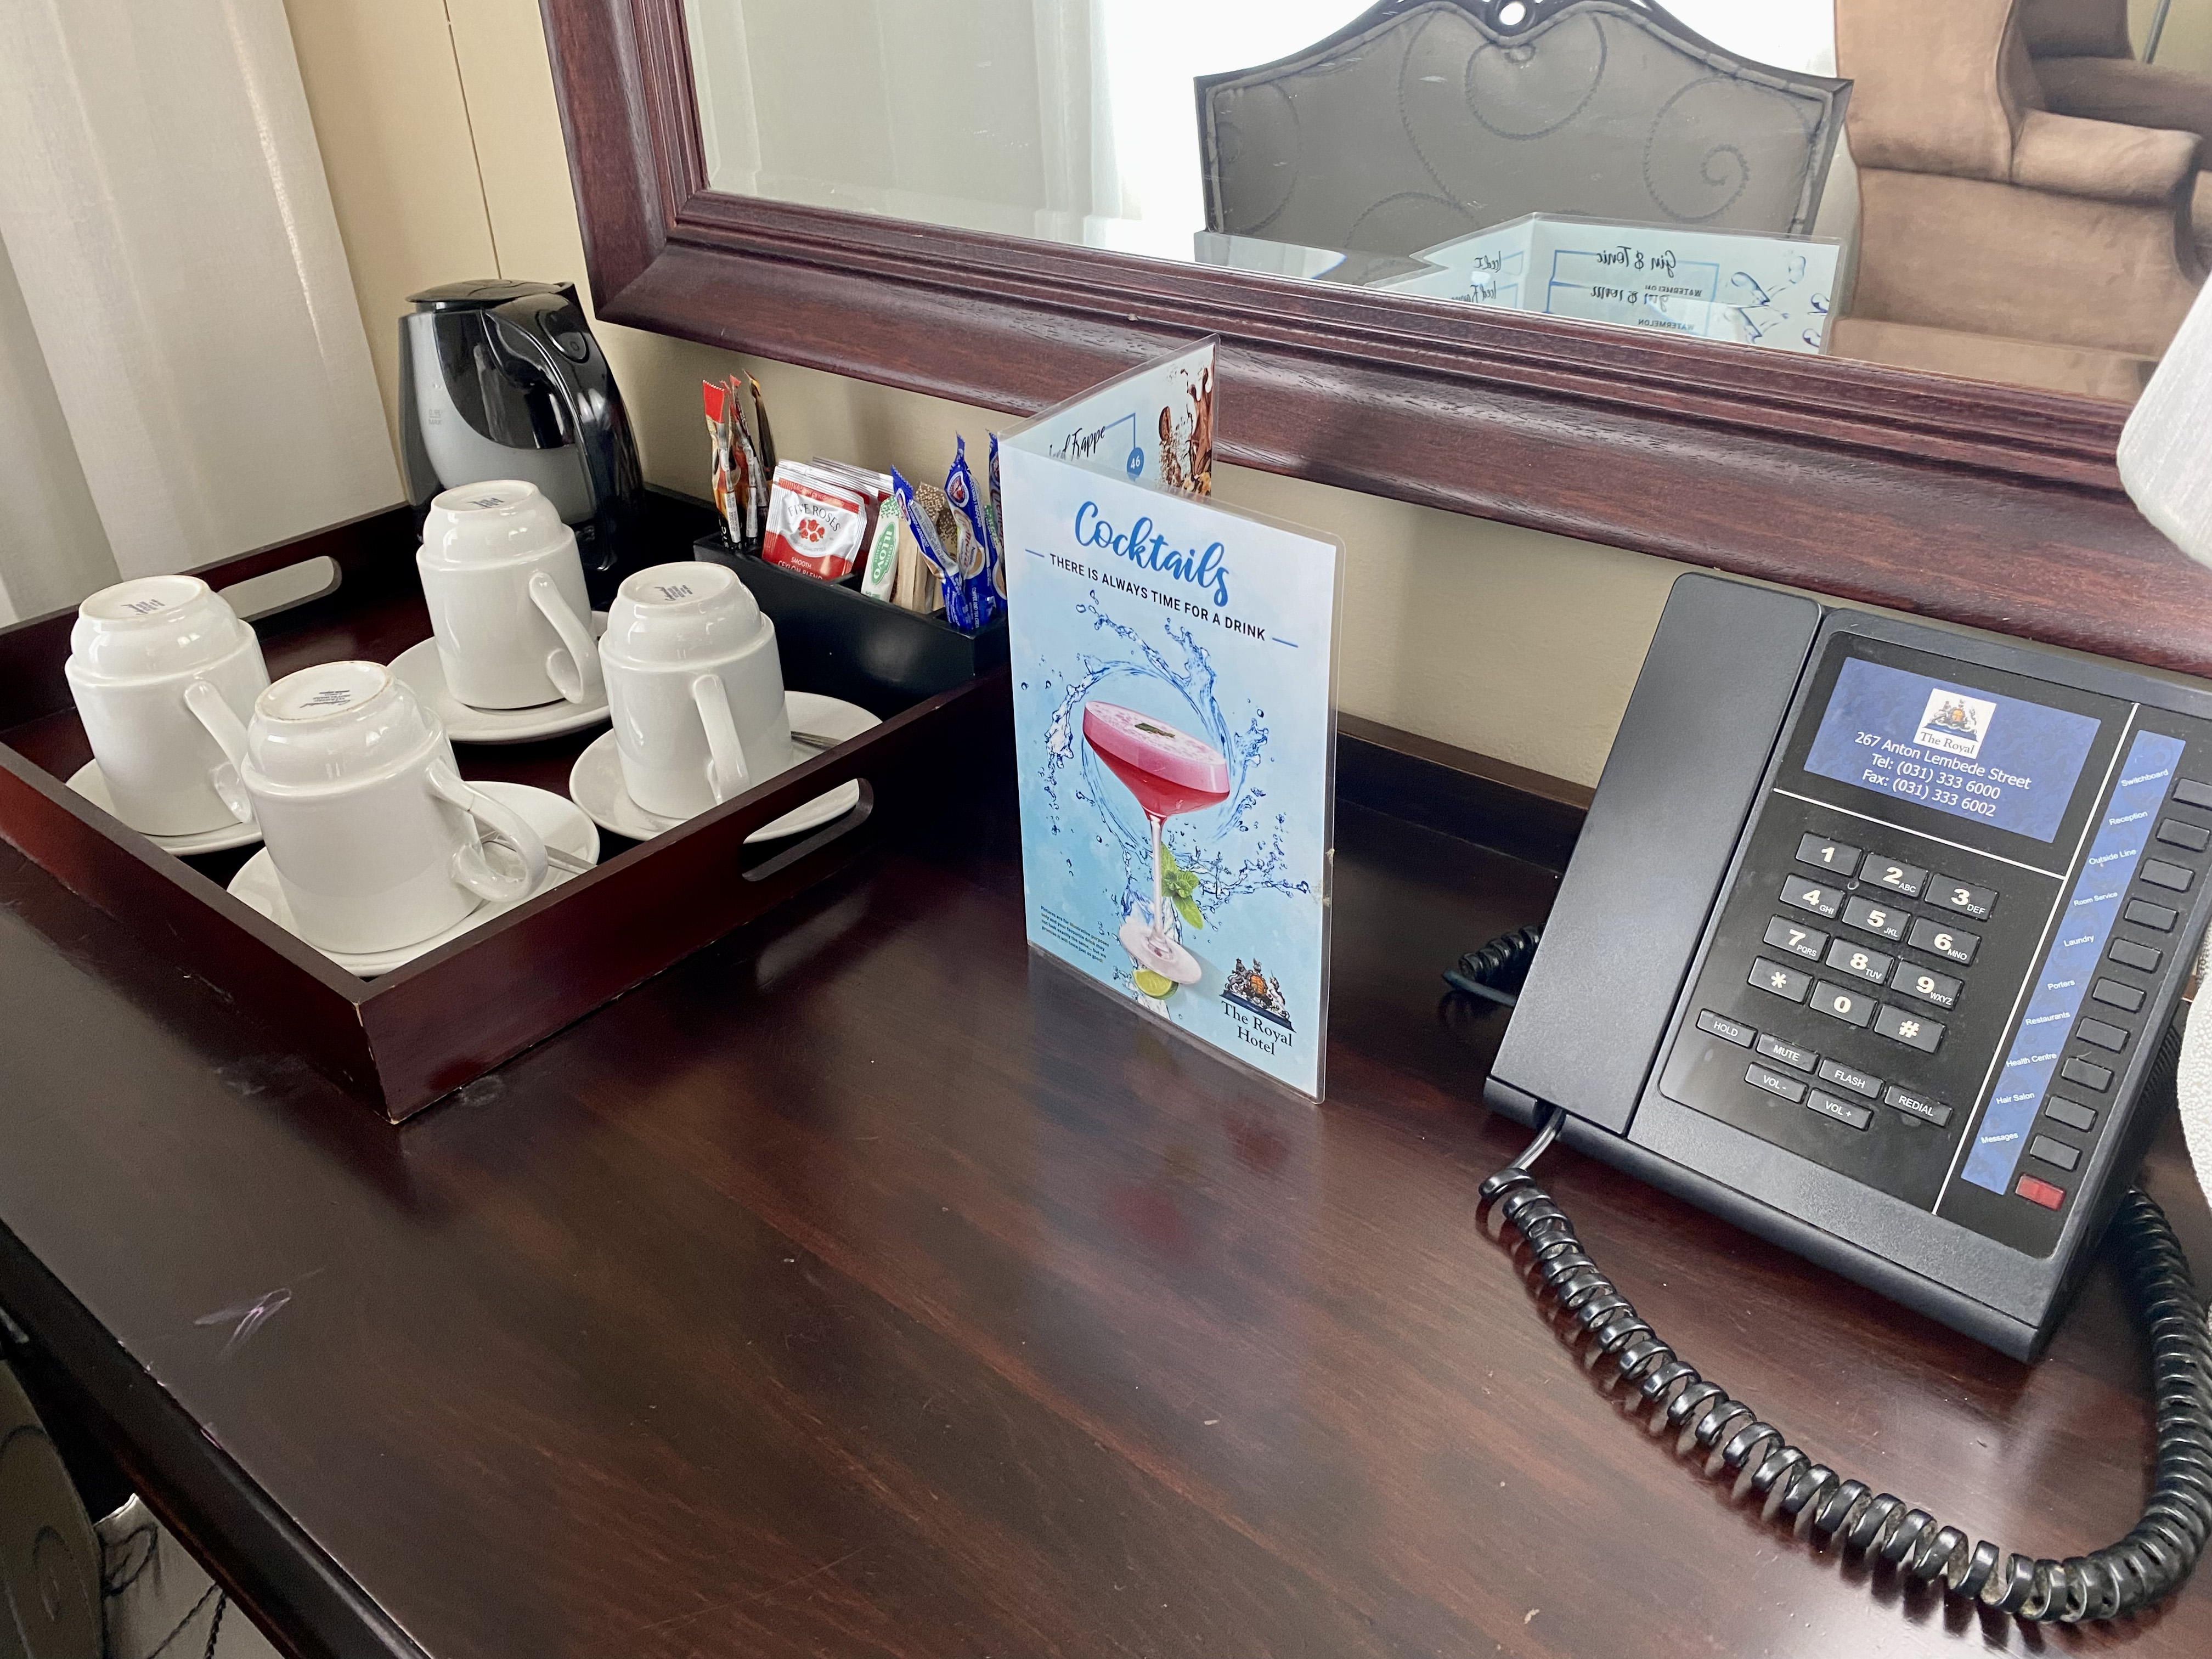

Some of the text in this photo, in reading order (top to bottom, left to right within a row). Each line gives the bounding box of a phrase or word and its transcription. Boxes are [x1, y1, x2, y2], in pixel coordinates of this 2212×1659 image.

[1071, 426, 1105, 461] Frappe
[1131, 455, 1140, 469] 46
[788, 503, 841, 532] FIVE ROSES
[791, 556, 812, 569] SMOOTH
[873, 531, 893, 579] ILLOVO
[1075, 501, 1229, 607] Cocktails
[1049, 554, 1266, 641] THERE IS ALWAYS TIME FOR A DRINK
[1920, 732, 1975, 754] The Royal
[1855, 731, 2032, 790] 267 Anton Lembede Street
[1872, 753, 2001, 799] Tel: (031) 333 6000
[2121, 769, 2169, 787] Switchboard
[1862, 769, 1996, 817] Fax: (031) 333 6002
[2109, 811, 2148, 826] Reception
[1821, 847, 1835, 863] 1
[2089, 849, 2136, 865] Outside Line
[1882, 866, 1903, 885] 2
[1898, 882, 1917, 894] ABC
[1951, 888, 1970, 905] 3
[1802, 889, 1820, 906] 4
[2074, 891, 2118, 906] Room Service
[1819, 903, 1835, 915] GHI
[1967, 904, 1985, 915] DEF
[1867, 910, 1887, 928] 5
[1788, 929, 1807, 946] 7
[1883, 927, 1899, 938] JKL
[2063, 935, 2094, 947] Laundry
[1797, 944, 1818, 957] PQRS
[1934, 933, 1953, 951] 6
[1850, 952, 1869, 970] 8
[1947, 949, 1968, 961] MNO
[1865, 968, 1883, 980] TUV
[1916, 976, 1935, 994] 9
[2047, 979, 2075, 991] Porters
[1833, 996, 1852, 1013] 0
[1930, 992, 1953, 1006] WXYZ
[1221, 1001, 1293, 1047] The Royal
[2025, 1011, 2070, 1026] Restaurants
[1713, 1020, 1738, 1037] HOLD
[1238, 1025, 1275, 1056] Hotel
[1773, 1045, 1800, 1062] MUTE
[2006, 1052, 2057, 1068] Health Centre
[1763, 1075, 1780, 1089] VOL
[1835, 1070, 1866, 1089] FLASH
[1898, 1095, 1934, 1117] REDIAL
[1996, 1092, 2035, 1104] Hair Salon
[1825, 1101, 1843, 1115] VOL
[1980, 1132, 2018, 1144] Messages
